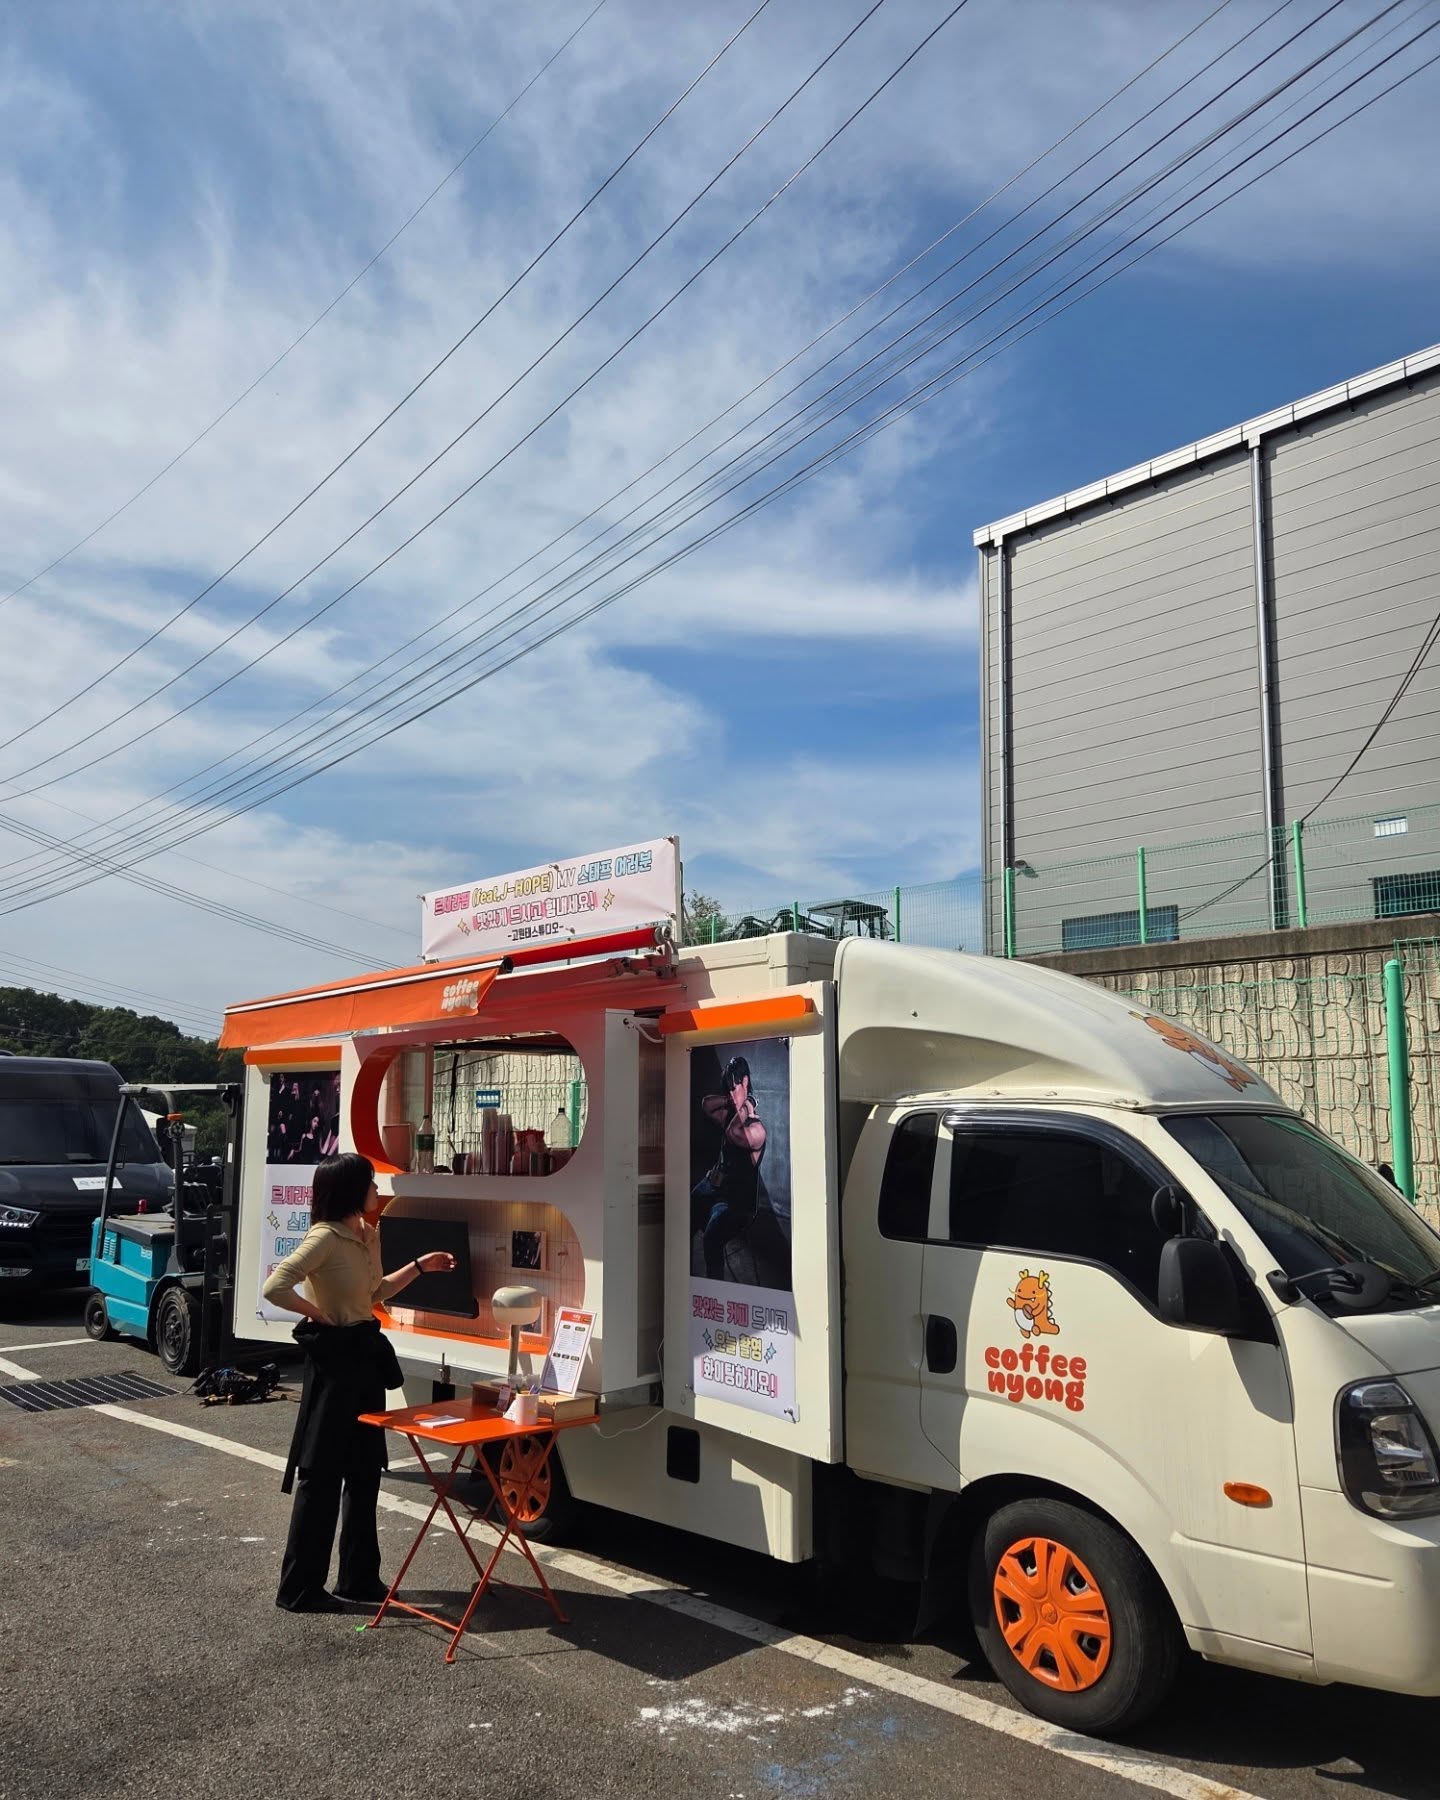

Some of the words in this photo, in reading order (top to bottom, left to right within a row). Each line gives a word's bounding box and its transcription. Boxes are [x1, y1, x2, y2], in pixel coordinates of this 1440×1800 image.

[434, 890, 471, 916] 르세라핌
[556, 867, 576, 890] MV
[577, 858, 613, 885] 스태프
[614, 849, 653, 877] 여러분
[475, 906, 509, 932] 맛있게
[509, 900, 543, 925] 드시고
[544, 890, 595, 919] 힘내세요!
[443, 978, 480, 998] coffee
[692, 1295, 725, 1324] 맛있는
[727, 1300, 750, 1328] 커피
[751, 1305, 789, 1336] 드시고
[714, 1328, 737, 1357] 오늘
[739, 1332, 763, 1362] 촬영
[984, 1342, 1088, 1381] coffee
[702, 1355, 777, 1399] 화이팅하세요!
[987, 1370, 1085, 1413] nyong
